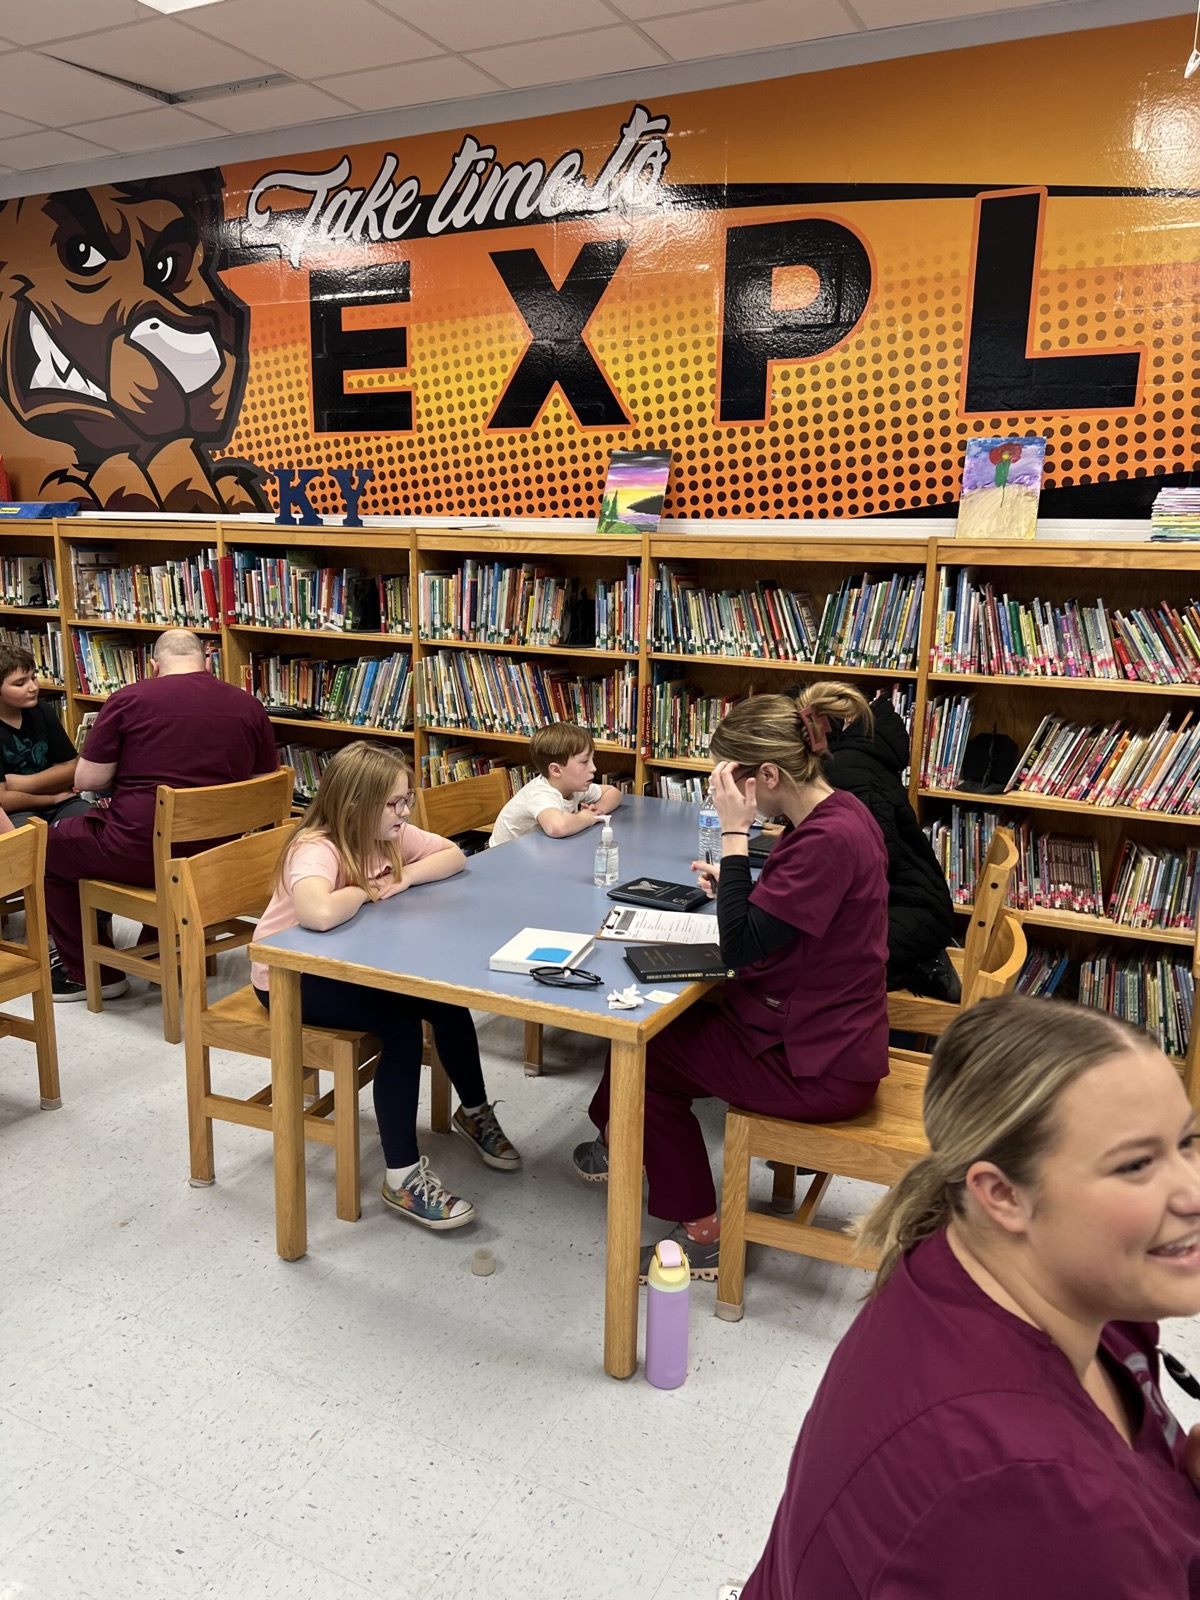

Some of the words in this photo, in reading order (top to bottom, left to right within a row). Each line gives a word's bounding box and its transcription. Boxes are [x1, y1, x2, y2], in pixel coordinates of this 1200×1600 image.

[248, 153, 421, 268] Take
[427, 134, 584, 236] time
[594, 104, 671, 211] to
[309, 187, 1145, 433] EXPL
[273, 469, 374, 527] KY
